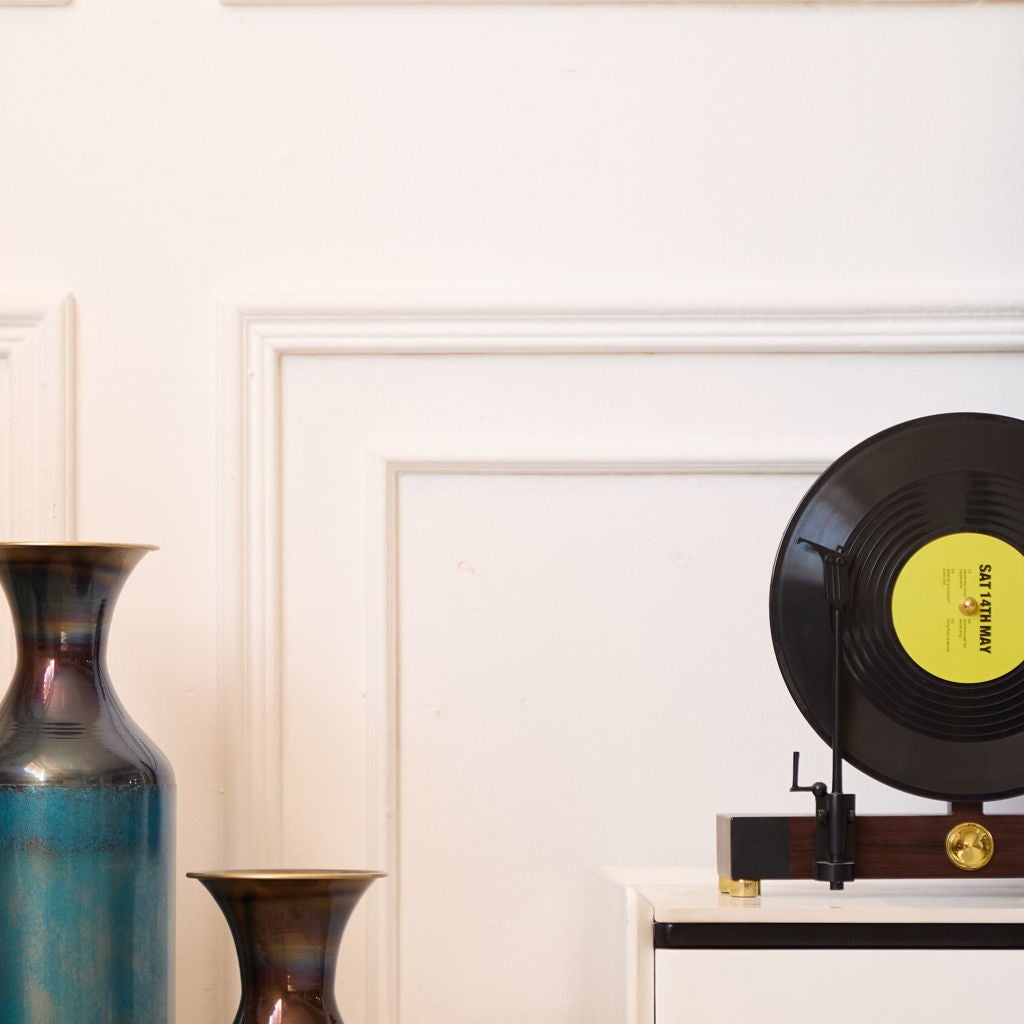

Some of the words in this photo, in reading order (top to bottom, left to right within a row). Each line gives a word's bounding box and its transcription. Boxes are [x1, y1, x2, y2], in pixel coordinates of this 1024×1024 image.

[979, 564, 992, 589] SAT
[979, 592, 992, 622] 14TH
[979, 625, 992, 654] MAY
